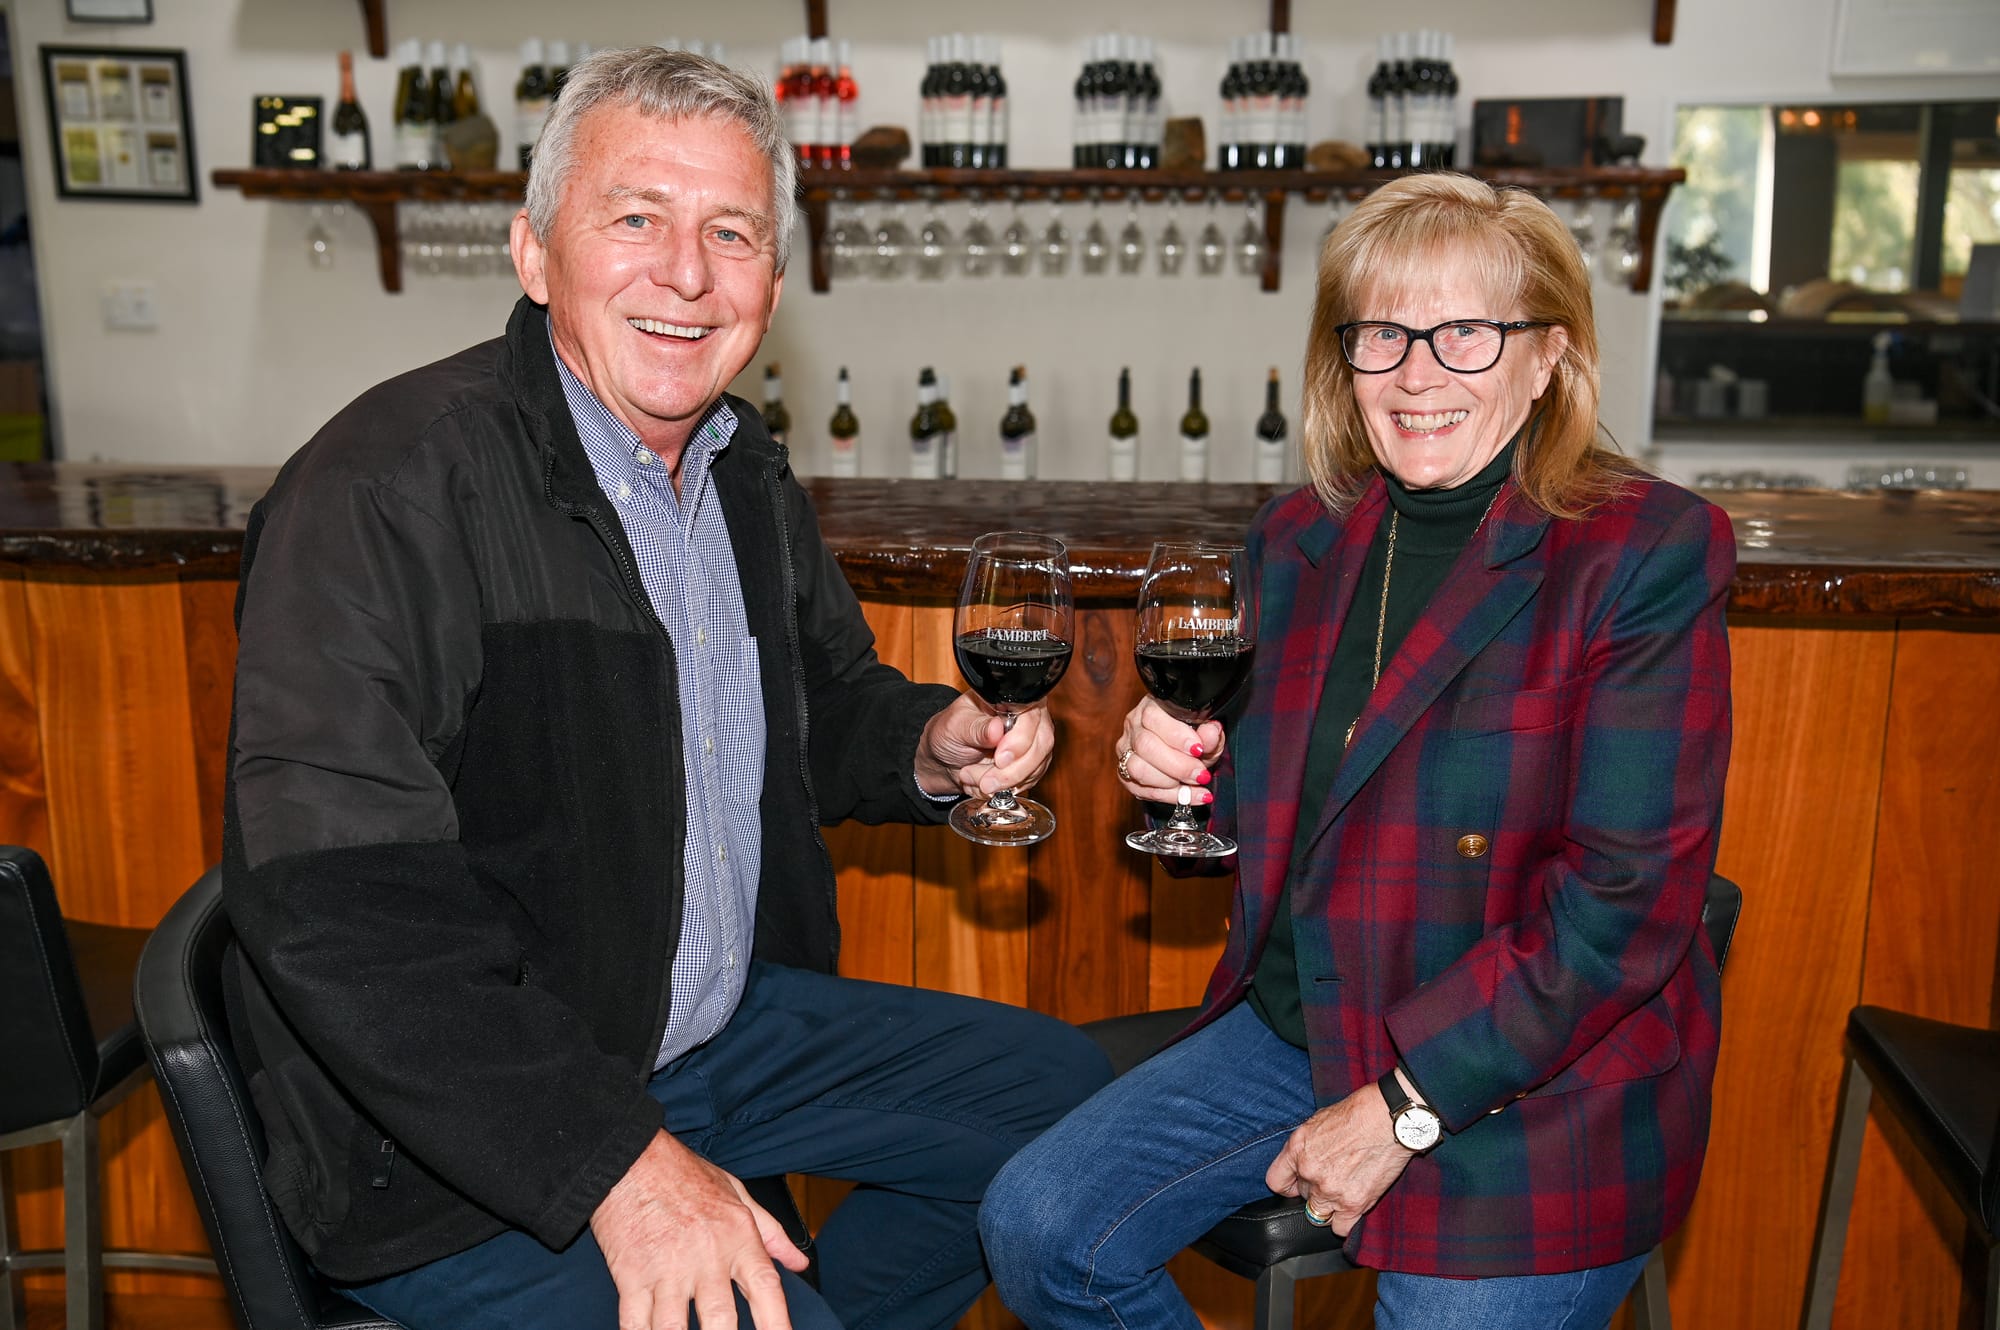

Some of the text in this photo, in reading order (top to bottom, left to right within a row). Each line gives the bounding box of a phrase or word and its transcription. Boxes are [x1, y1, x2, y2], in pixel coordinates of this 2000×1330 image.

[1178, 616, 1239, 631] LAMBERT
[986, 626, 1049, 642] LAMBERT
[986, 658, 1017, 667] BAROSSA
